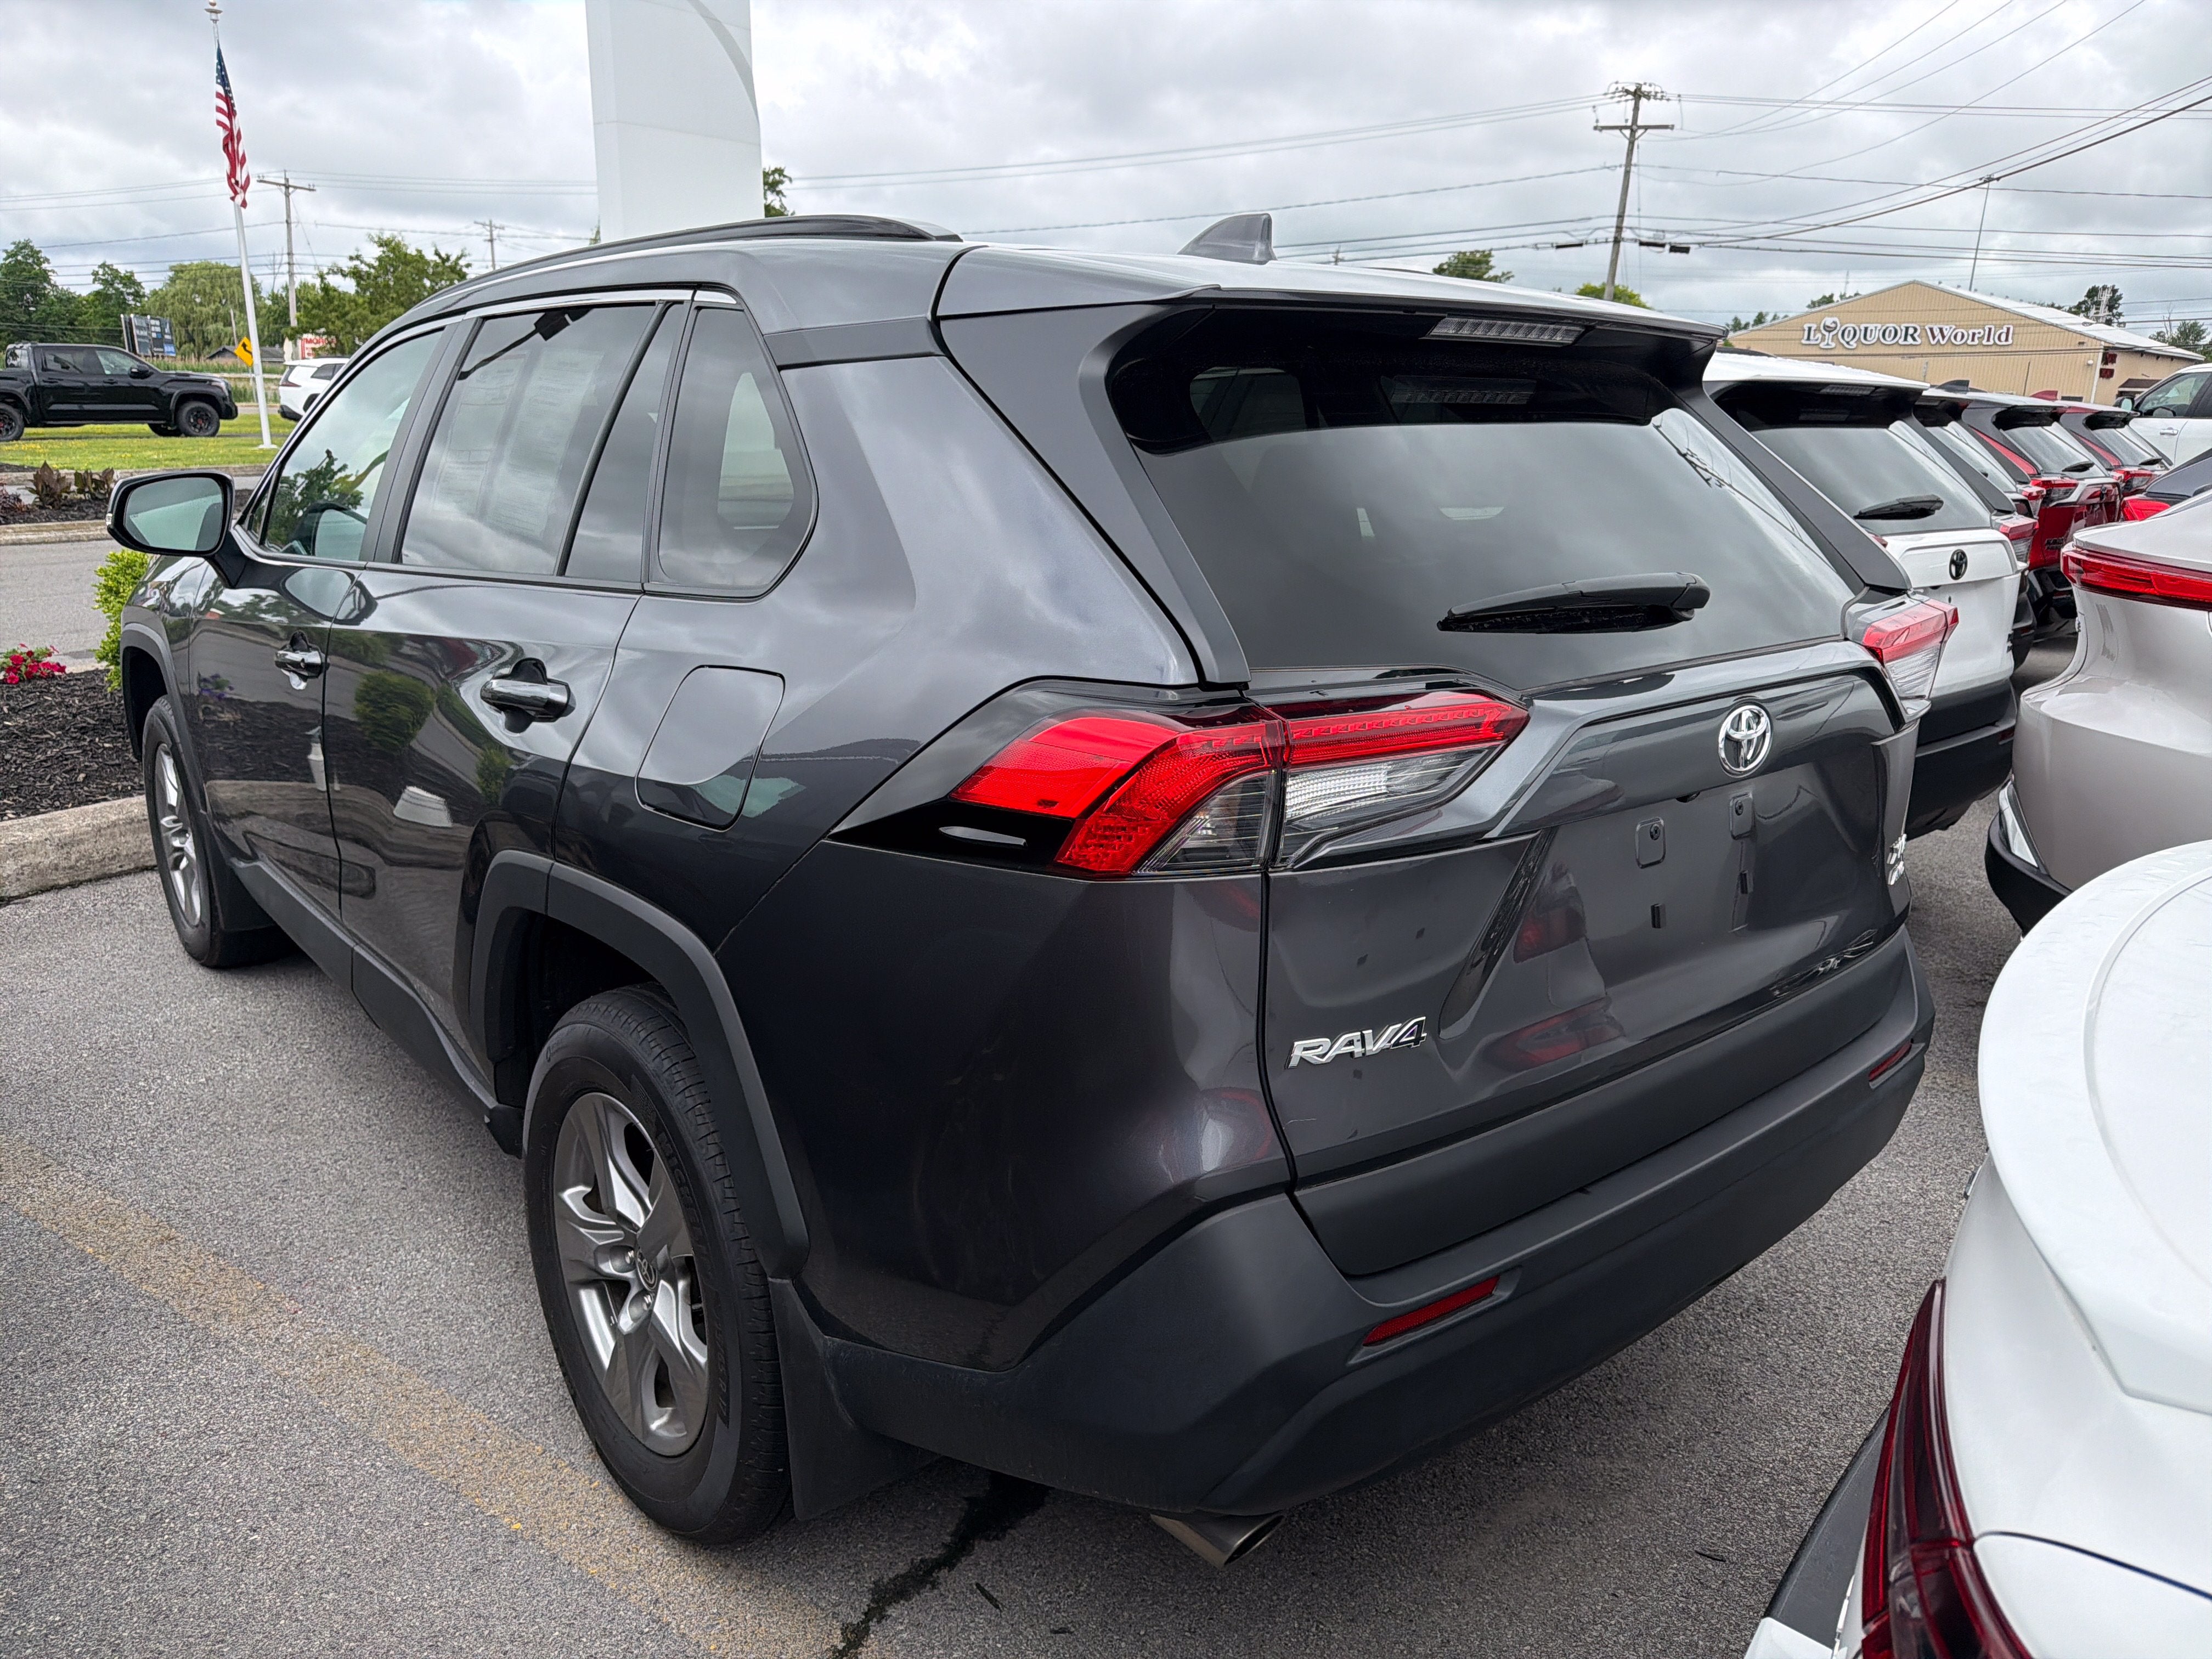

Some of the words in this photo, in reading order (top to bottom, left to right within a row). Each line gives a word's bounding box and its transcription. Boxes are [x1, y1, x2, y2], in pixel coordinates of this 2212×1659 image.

[1802, 318, 1920, 348] LIQUOR
[1925, 325, 2013, 345] World
[1285, 1016, 1427, 1069] RAV4
